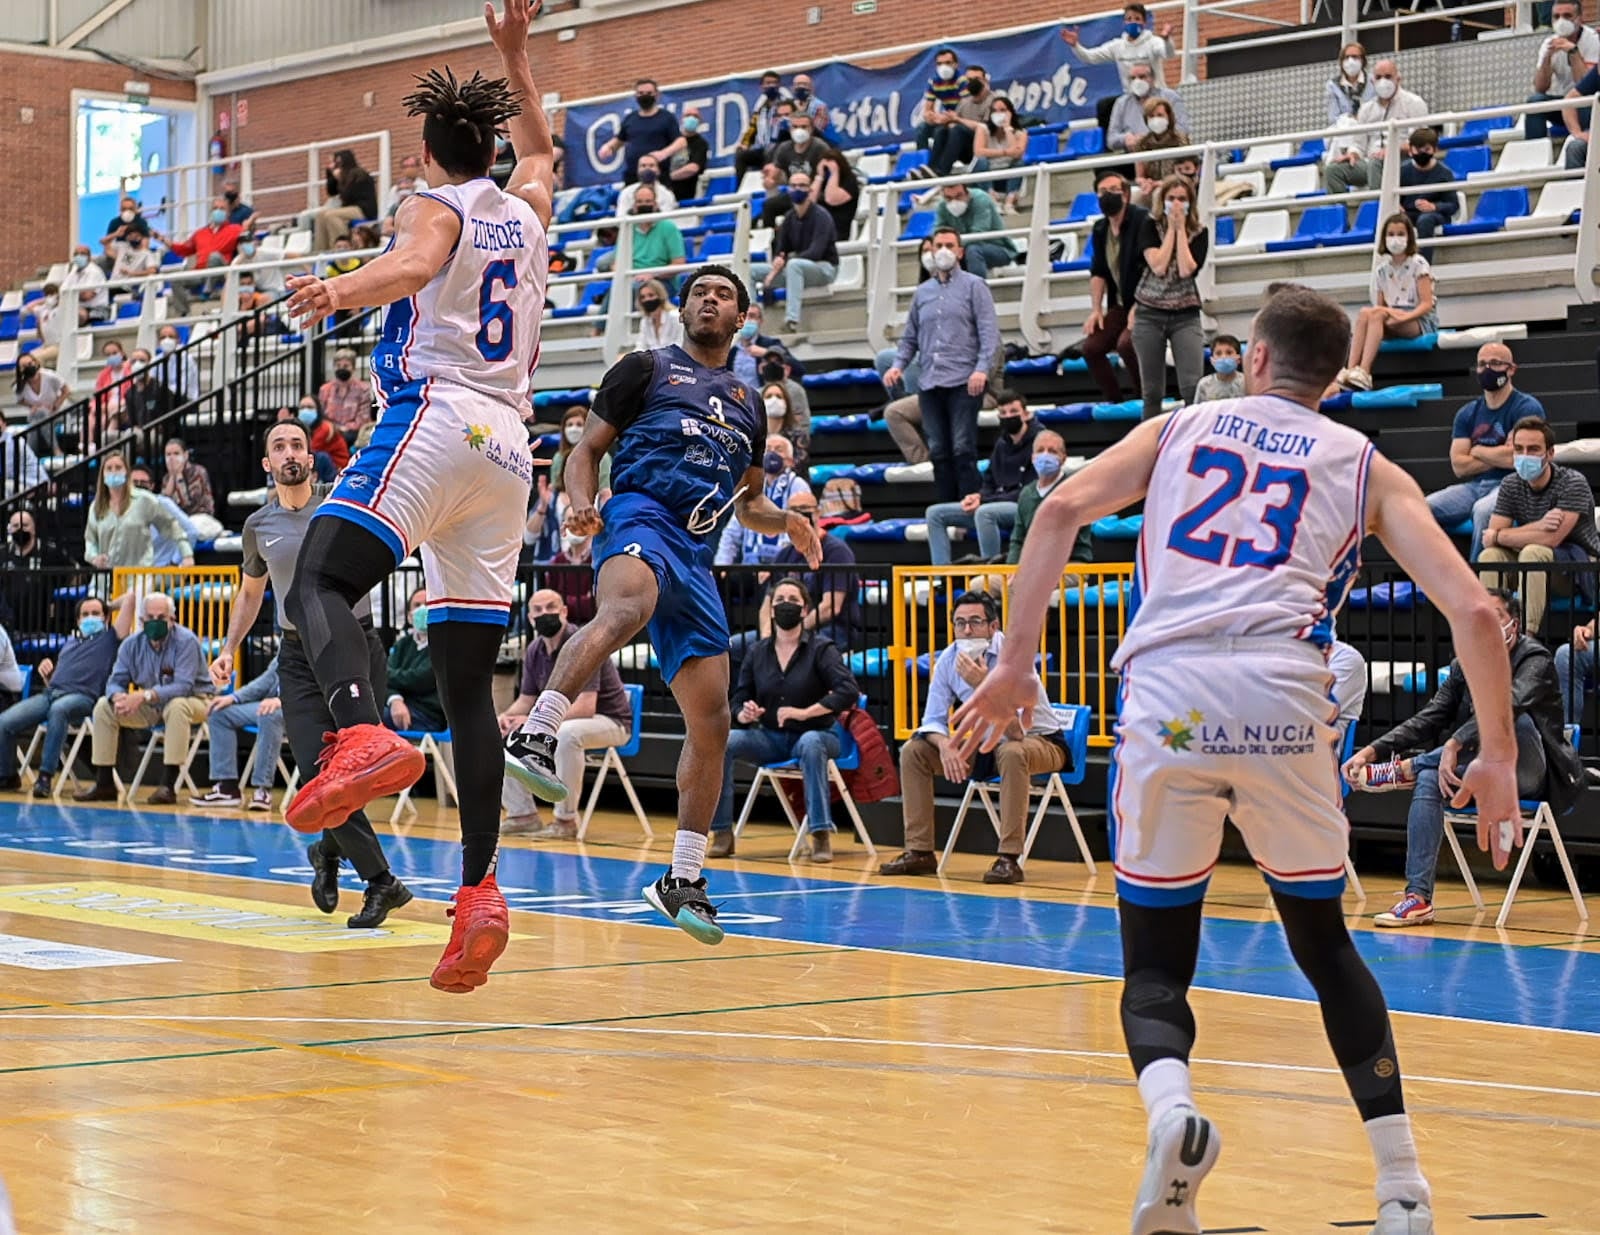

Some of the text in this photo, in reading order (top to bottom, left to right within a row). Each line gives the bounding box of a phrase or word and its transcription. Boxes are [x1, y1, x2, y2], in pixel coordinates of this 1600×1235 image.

[475, 259, 518, 363] 6
[708, 395, 725, 423] 3
[1212, 414, 1317, 457] URTASUN
[509, 449, 531, 473] NUC
[1167, 445, 1311, 571] 23
[1202, 724, 1229, 742] LA
[1201, 744, 1247, 756] CIUDAD
[1249, 743, 1268, 755] DEL
